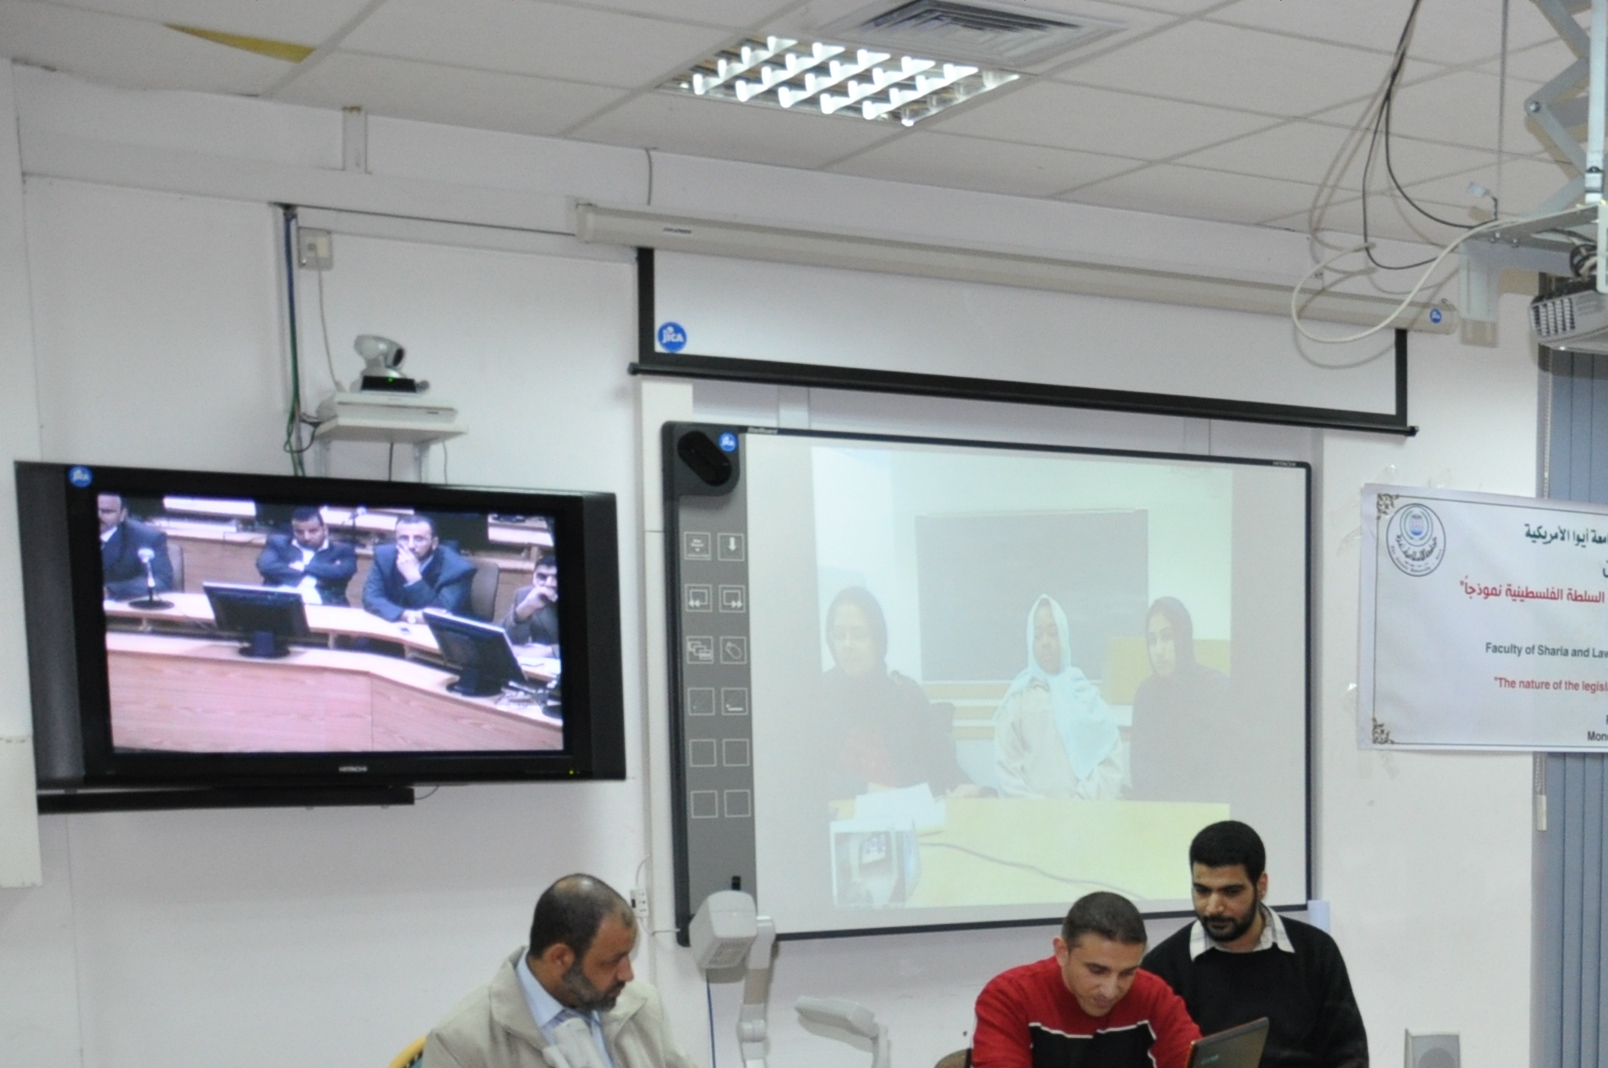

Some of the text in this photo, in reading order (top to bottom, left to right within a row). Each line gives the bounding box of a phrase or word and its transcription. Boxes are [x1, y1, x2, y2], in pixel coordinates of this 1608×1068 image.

[1524, 523, 1570, 544] الأمريكية
[1573, 526, 1588, 548] أيوا
[1505, 583, 1563, 602] الفلسطينية
[1566, 588, 1605, 604] السلطة
[1485, 642, 1522, 657] Faculty
[1525, 644, 1536, 655] of
[1537, 645, 1569, 657] Sharia
[1571, 647, 1590, 658] and
[1494, 677, 1516, 689] "The
[1519, 679, 1550, 690] nature
[1552, 680, 1563, 690] of
[1564, 680, 1580, 691] the
